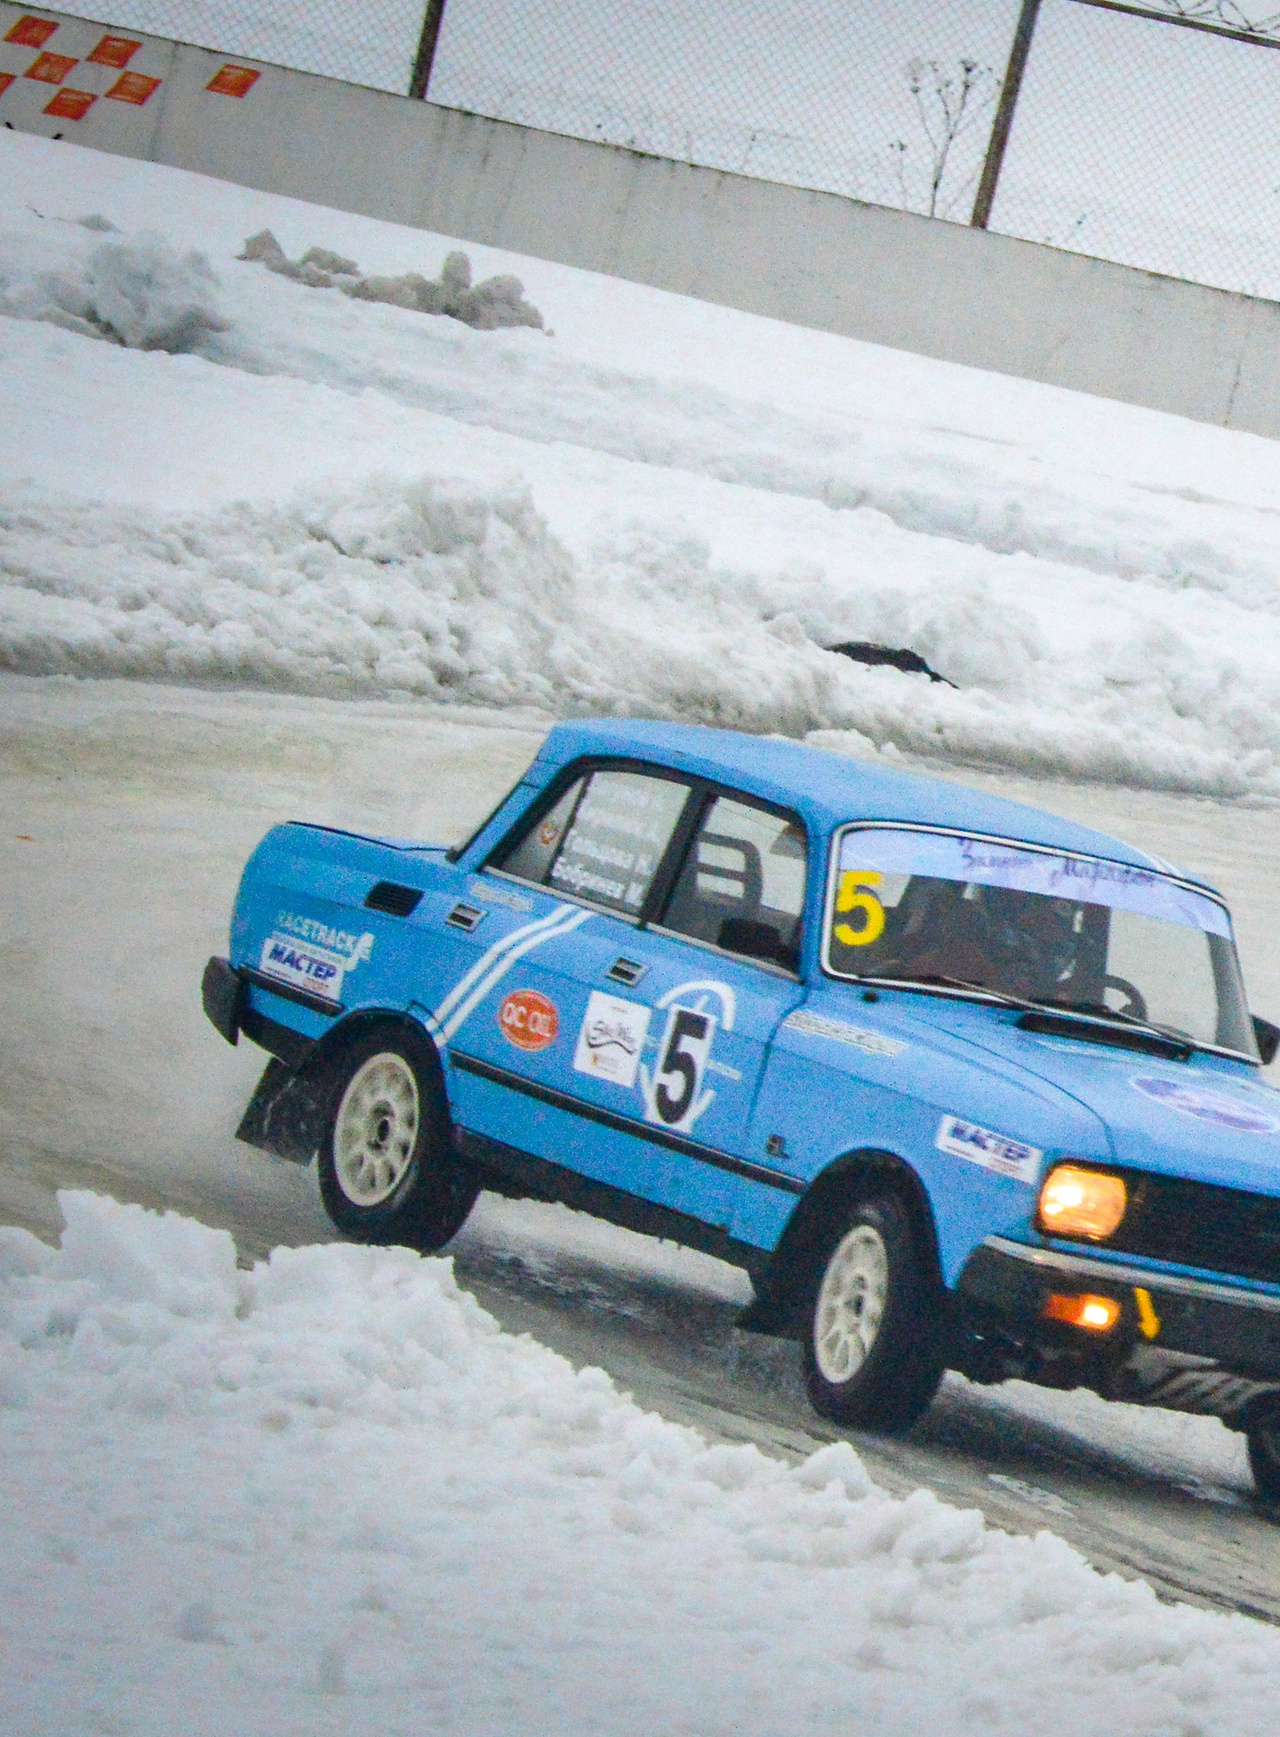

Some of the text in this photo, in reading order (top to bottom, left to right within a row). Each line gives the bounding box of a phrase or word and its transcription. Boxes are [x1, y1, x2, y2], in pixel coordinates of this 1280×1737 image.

[835, 870, 886, 946] 5
[268, 943, 338, 980] МАСТЕР
[655, 1009, 709, 1124] 5
